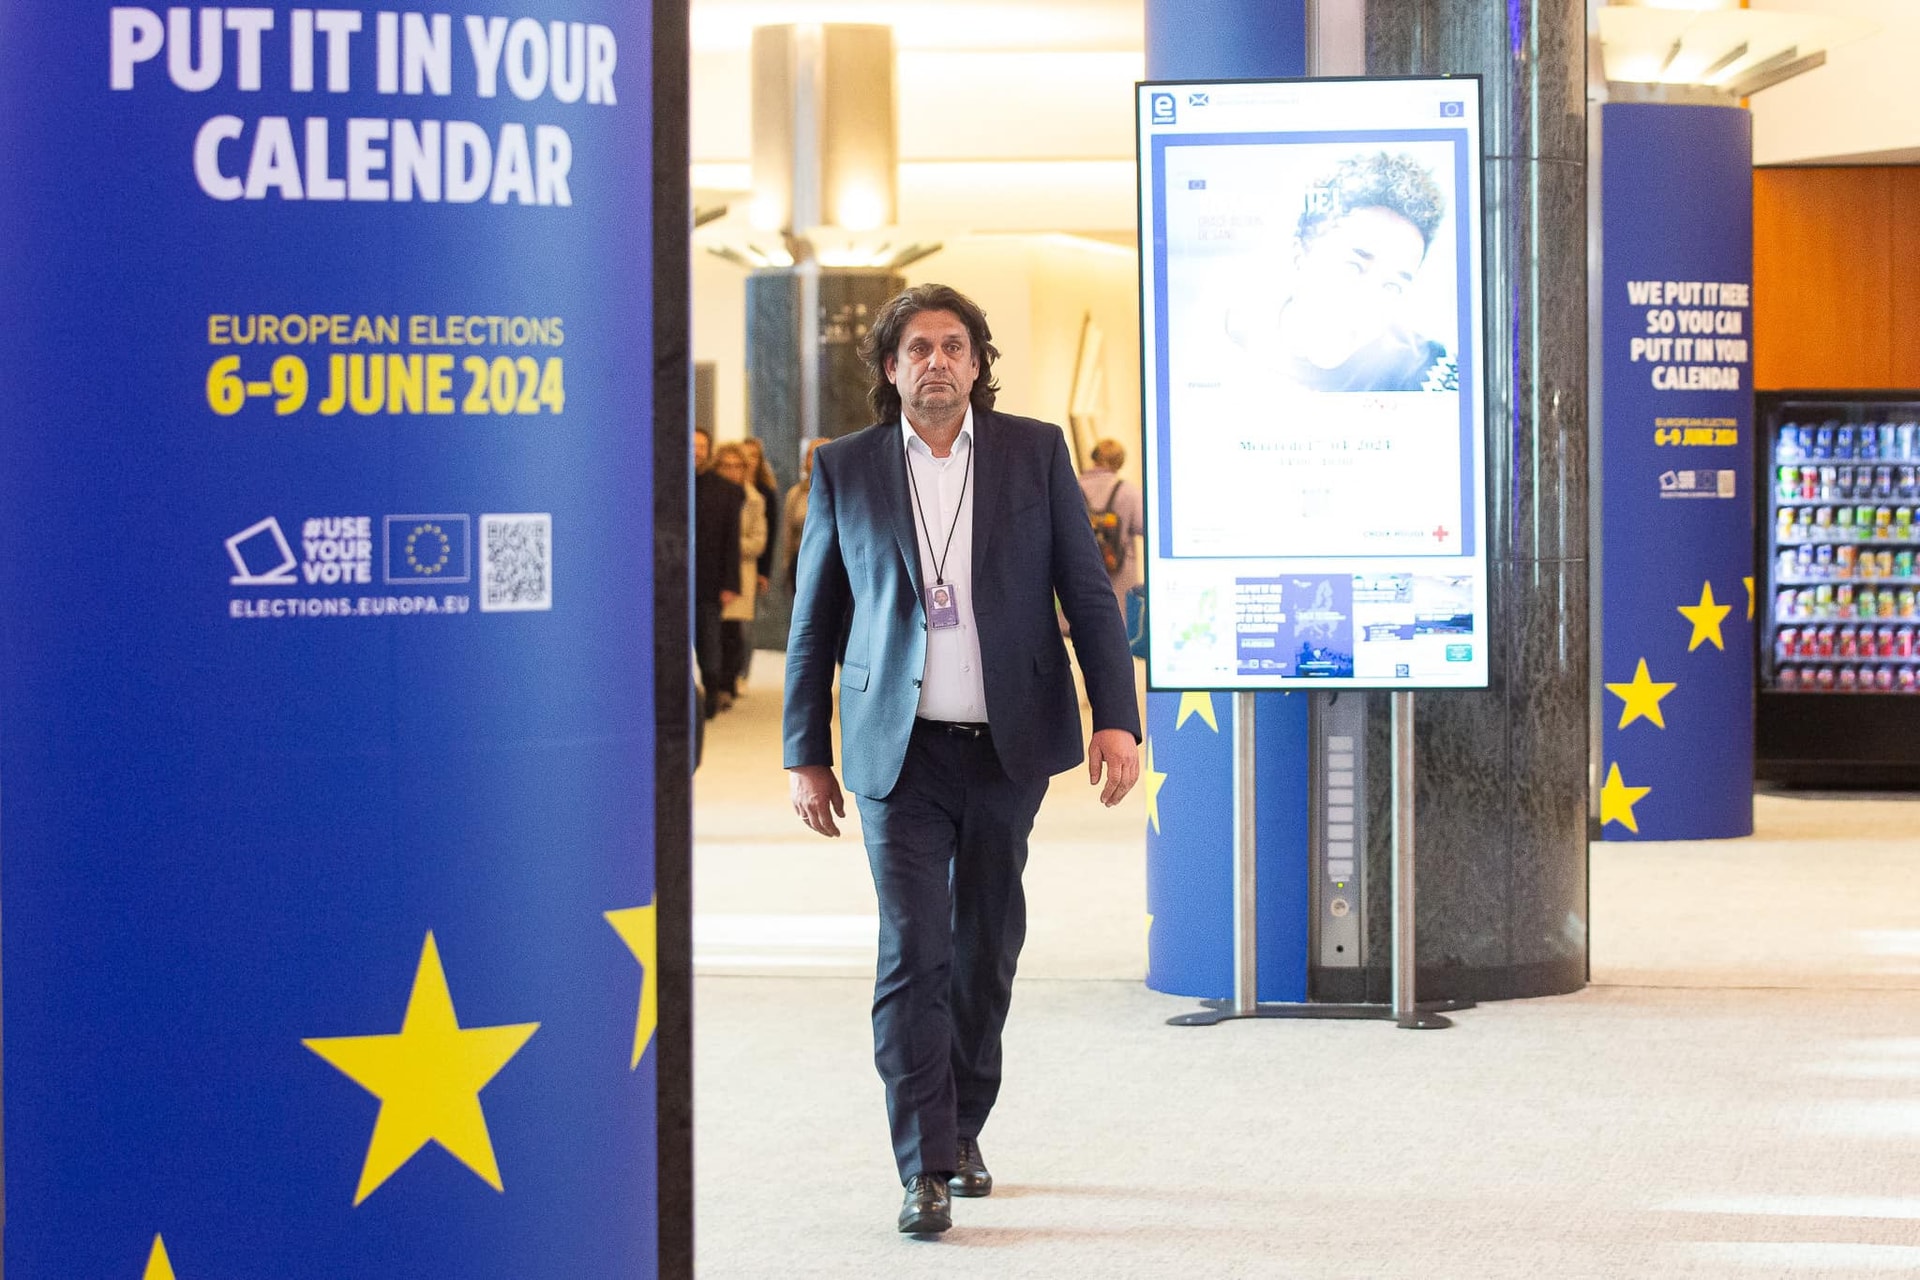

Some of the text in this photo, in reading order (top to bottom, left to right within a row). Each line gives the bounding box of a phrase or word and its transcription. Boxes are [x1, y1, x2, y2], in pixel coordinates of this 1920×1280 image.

[109, 6, 618, 106] PUT IT IN YOUR
[193, 114, 573, 207] CALENDAR
[1627, 281, 1749, 307] WE PUT IT HERE
[208, 314, 565, 347] EUROPEAN ELECTIONS
[1646, 309, 1742, 334] SO YOU CAN
[1630, 338, 1748, 363] PUT IT IN YOUR
[318, 354, 454, 417] JUNE
[462, 356, 566, 416] 2024
[1651, 366, 1740, 390] CALENDAR
[303, 516, 373, 539] #USE
[303, 538, 373, 562] YOUR
[302, 561, 372, 583] VOTE
[229, 596, 470, 617] ELECTIONS.EUROPA.EU
